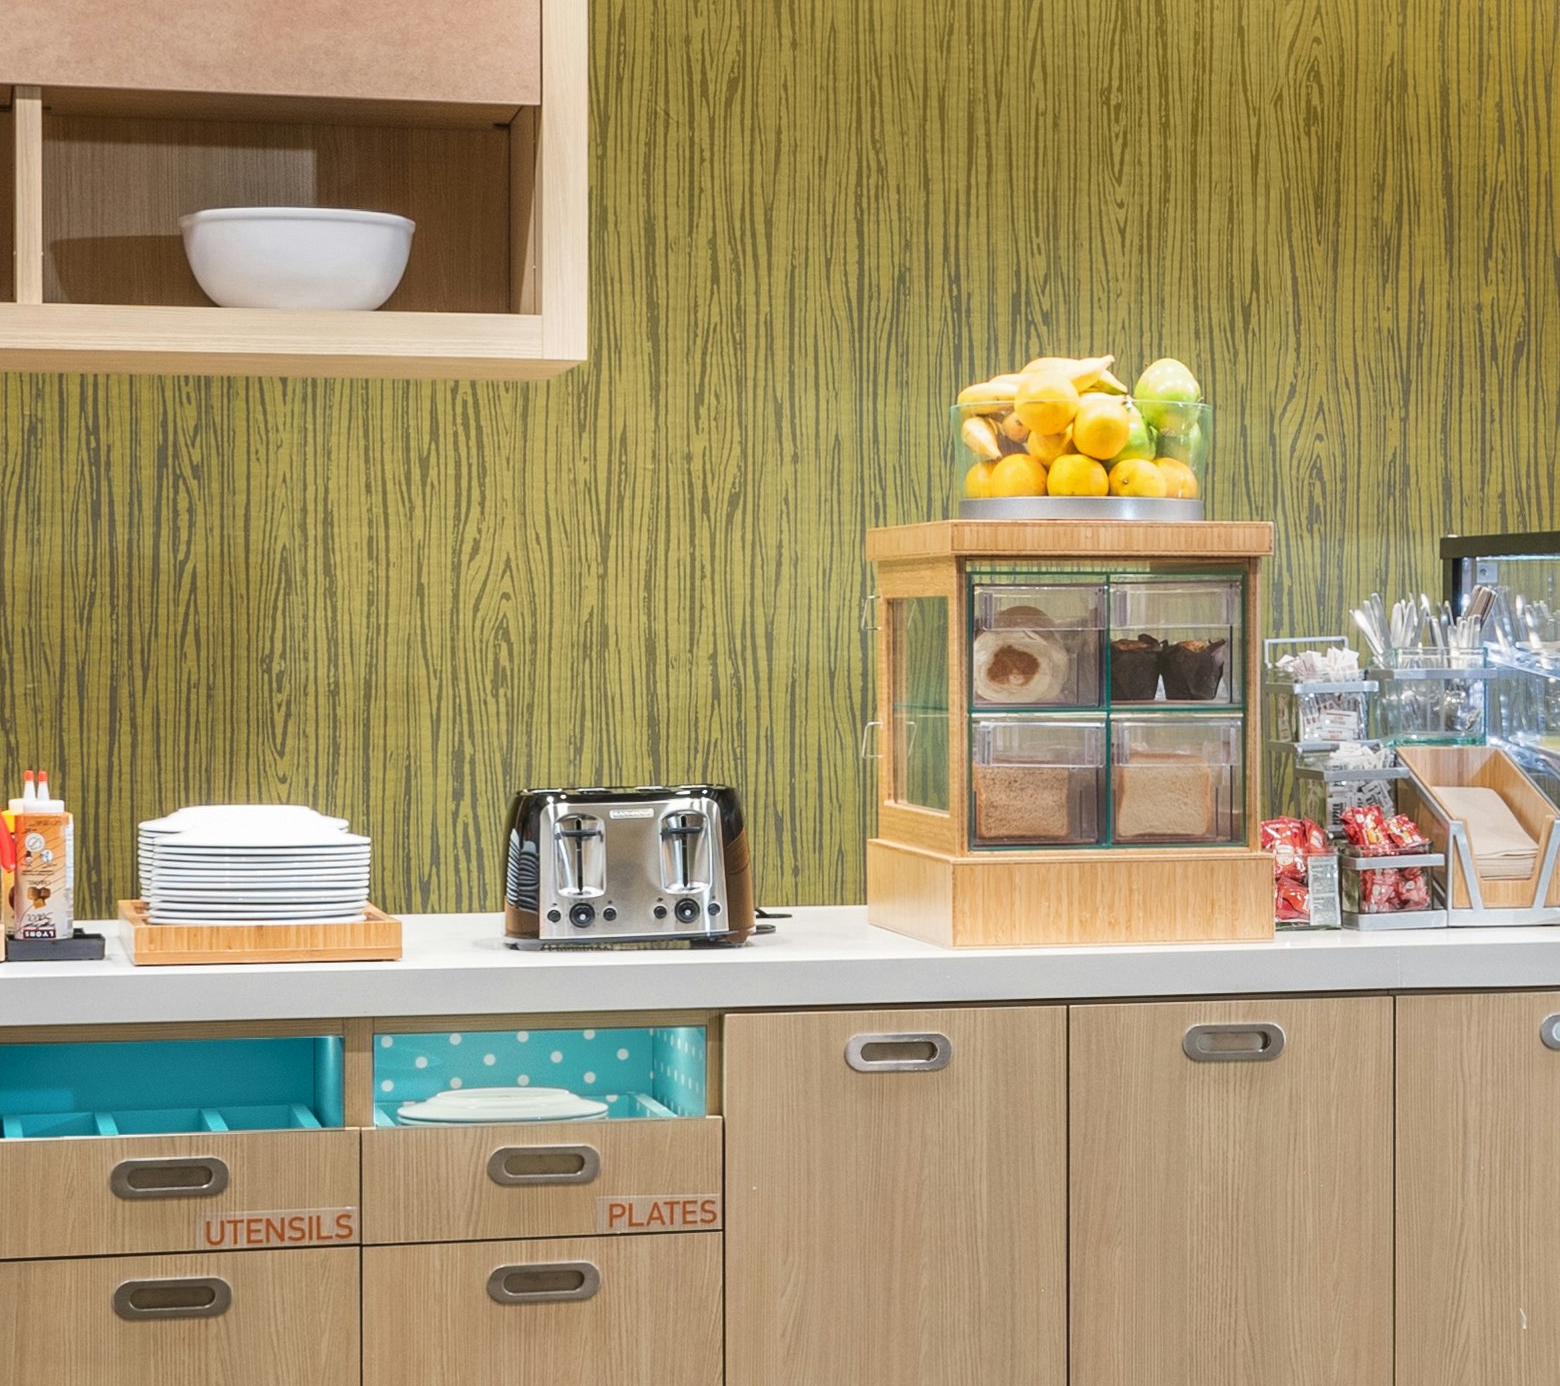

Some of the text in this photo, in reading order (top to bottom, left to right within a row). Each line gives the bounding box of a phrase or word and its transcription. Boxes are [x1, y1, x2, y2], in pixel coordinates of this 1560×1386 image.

[25, 929, 55, 937] LYONS
[608, 1199, 717, 1228] PLATES
[205, 1213, 353, 1246] UTENSILS
